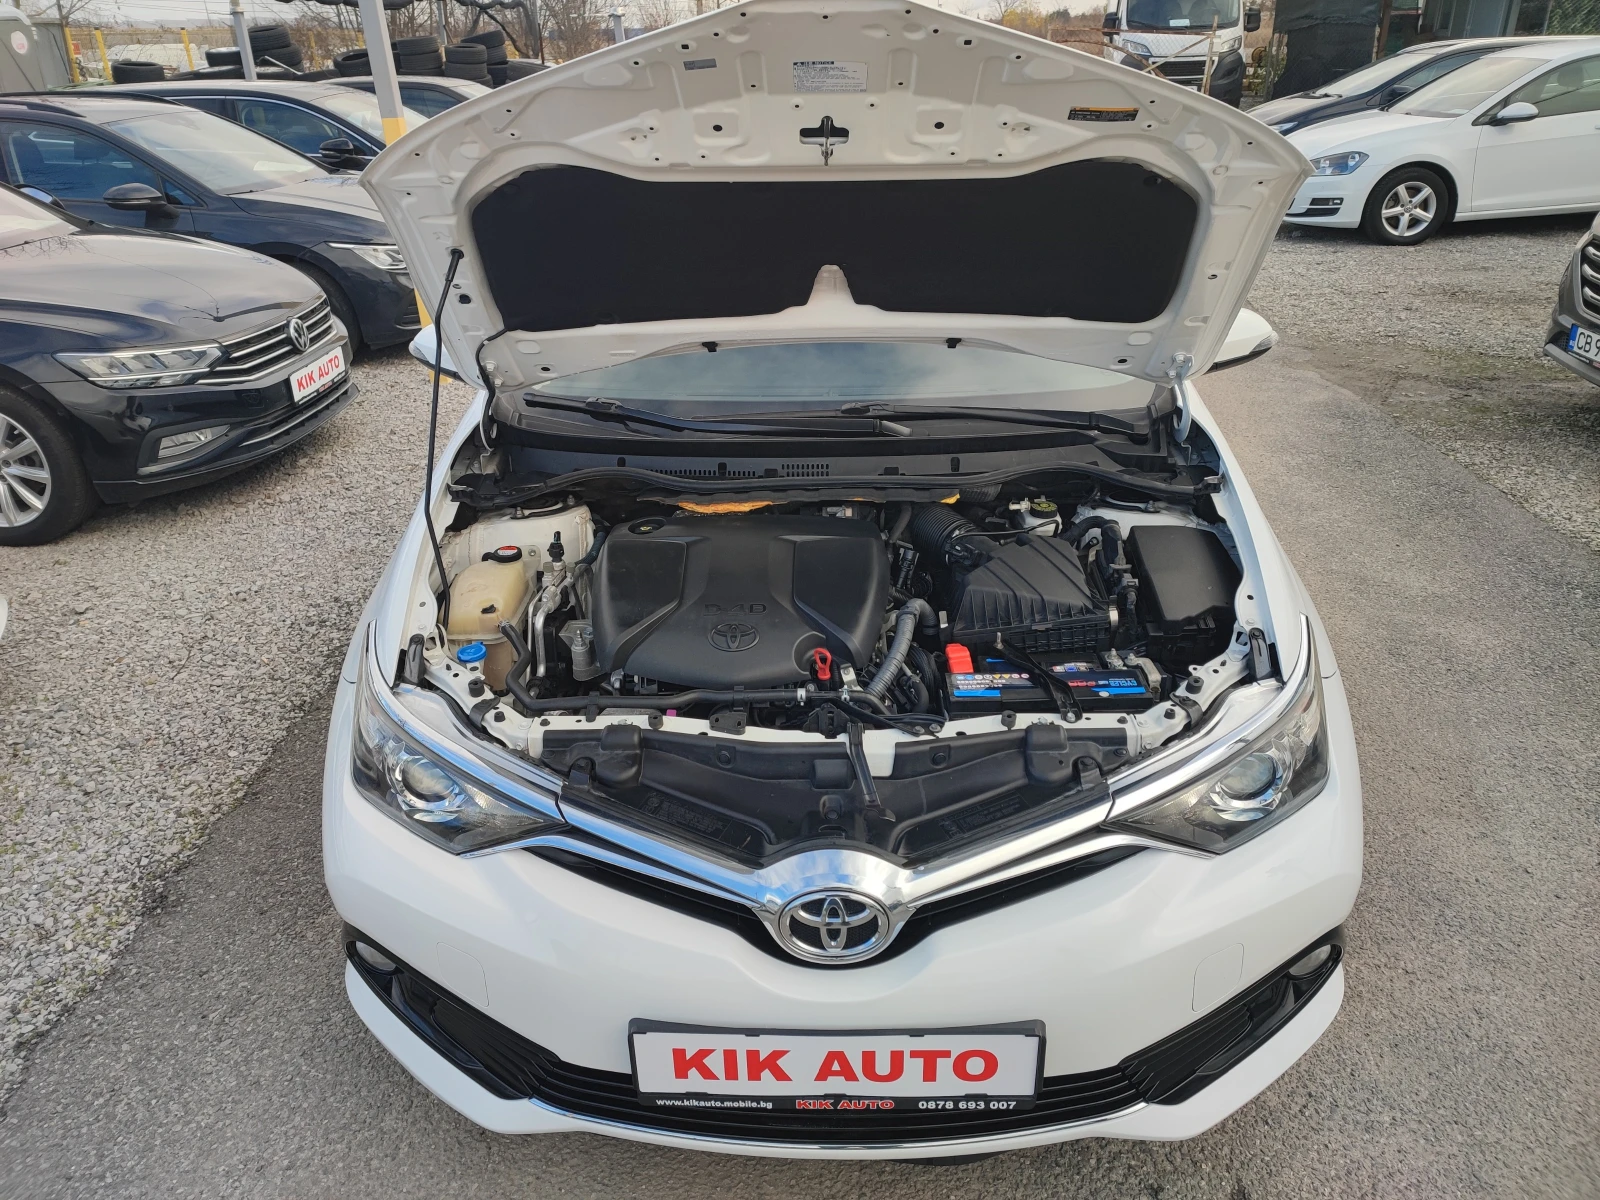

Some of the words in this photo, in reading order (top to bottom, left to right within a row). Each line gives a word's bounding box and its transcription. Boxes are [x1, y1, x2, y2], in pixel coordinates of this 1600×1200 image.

[1577, 332, 1592, 352] CB
[296, 370, 316, 392] KIK
[318, 355, 340, 380] AUTO
[672, 1048, 793, 1082] KIK
[813, 1049, 999, 1083] AUTO
[796, 1100, 834, 1109] KIK
[837, 1100, 895, 1109] AUTO
[918, 1101, 954, 1110] 0878
[958, 1101, 985, 1110] 693
[989, 1101, 1017, 1110] 007
